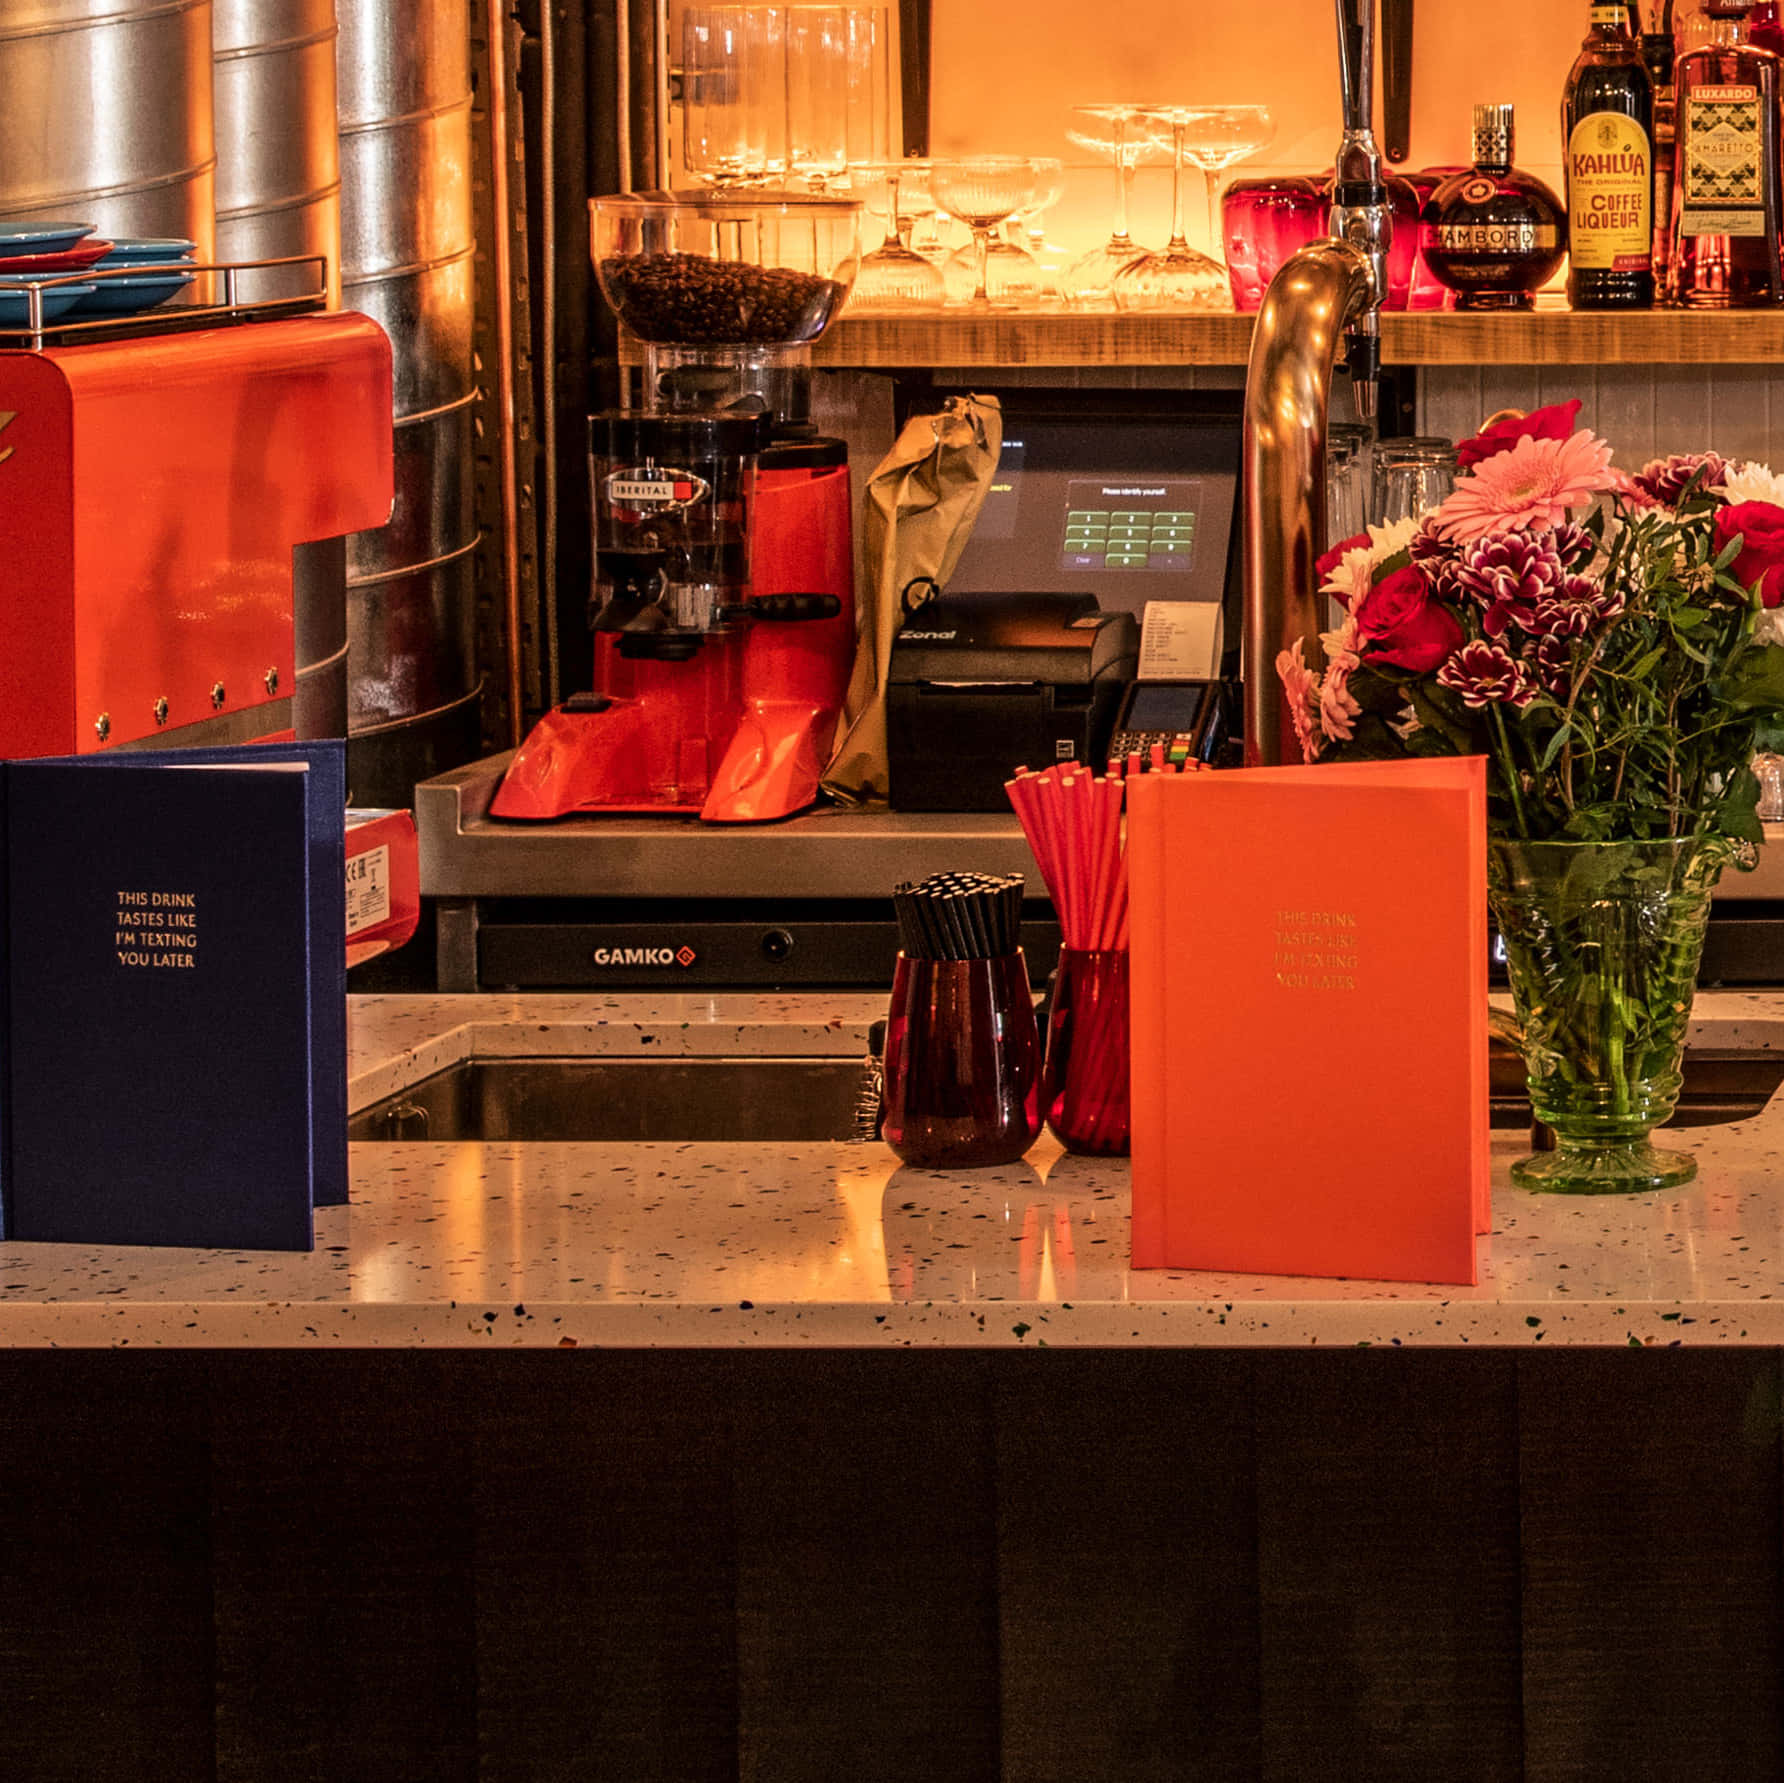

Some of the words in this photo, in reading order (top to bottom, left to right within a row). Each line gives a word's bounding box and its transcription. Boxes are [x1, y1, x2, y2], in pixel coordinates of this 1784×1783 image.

[1694, 88, 1753, 100] LUXARDO
[1695, 142, 1754, 154] AMARETTO
[1573, 143, 1645, 177] KAHLÚA
[1591, 193, 1643, 212] COFFEE
[1576, 212, 1640, 230] LIQUEUR
[616, 485, 668, 495] IBERITAL
[898, 629, 957, 641] Zonal
[117, 891, 148, 906] THIS
[151, 891, 196, 908] DRINK
[117, 912, 164, 927] TASTES
[168, 912, 197, 928] LIKE
[116, 932, 136, 946] I'M
[140, 932, 198, 948] TEXTING
[117, 952, 150, 967] YOU
[153, 953, 195, 968] LATER
[594, 948, 674, 965] GAMKO
